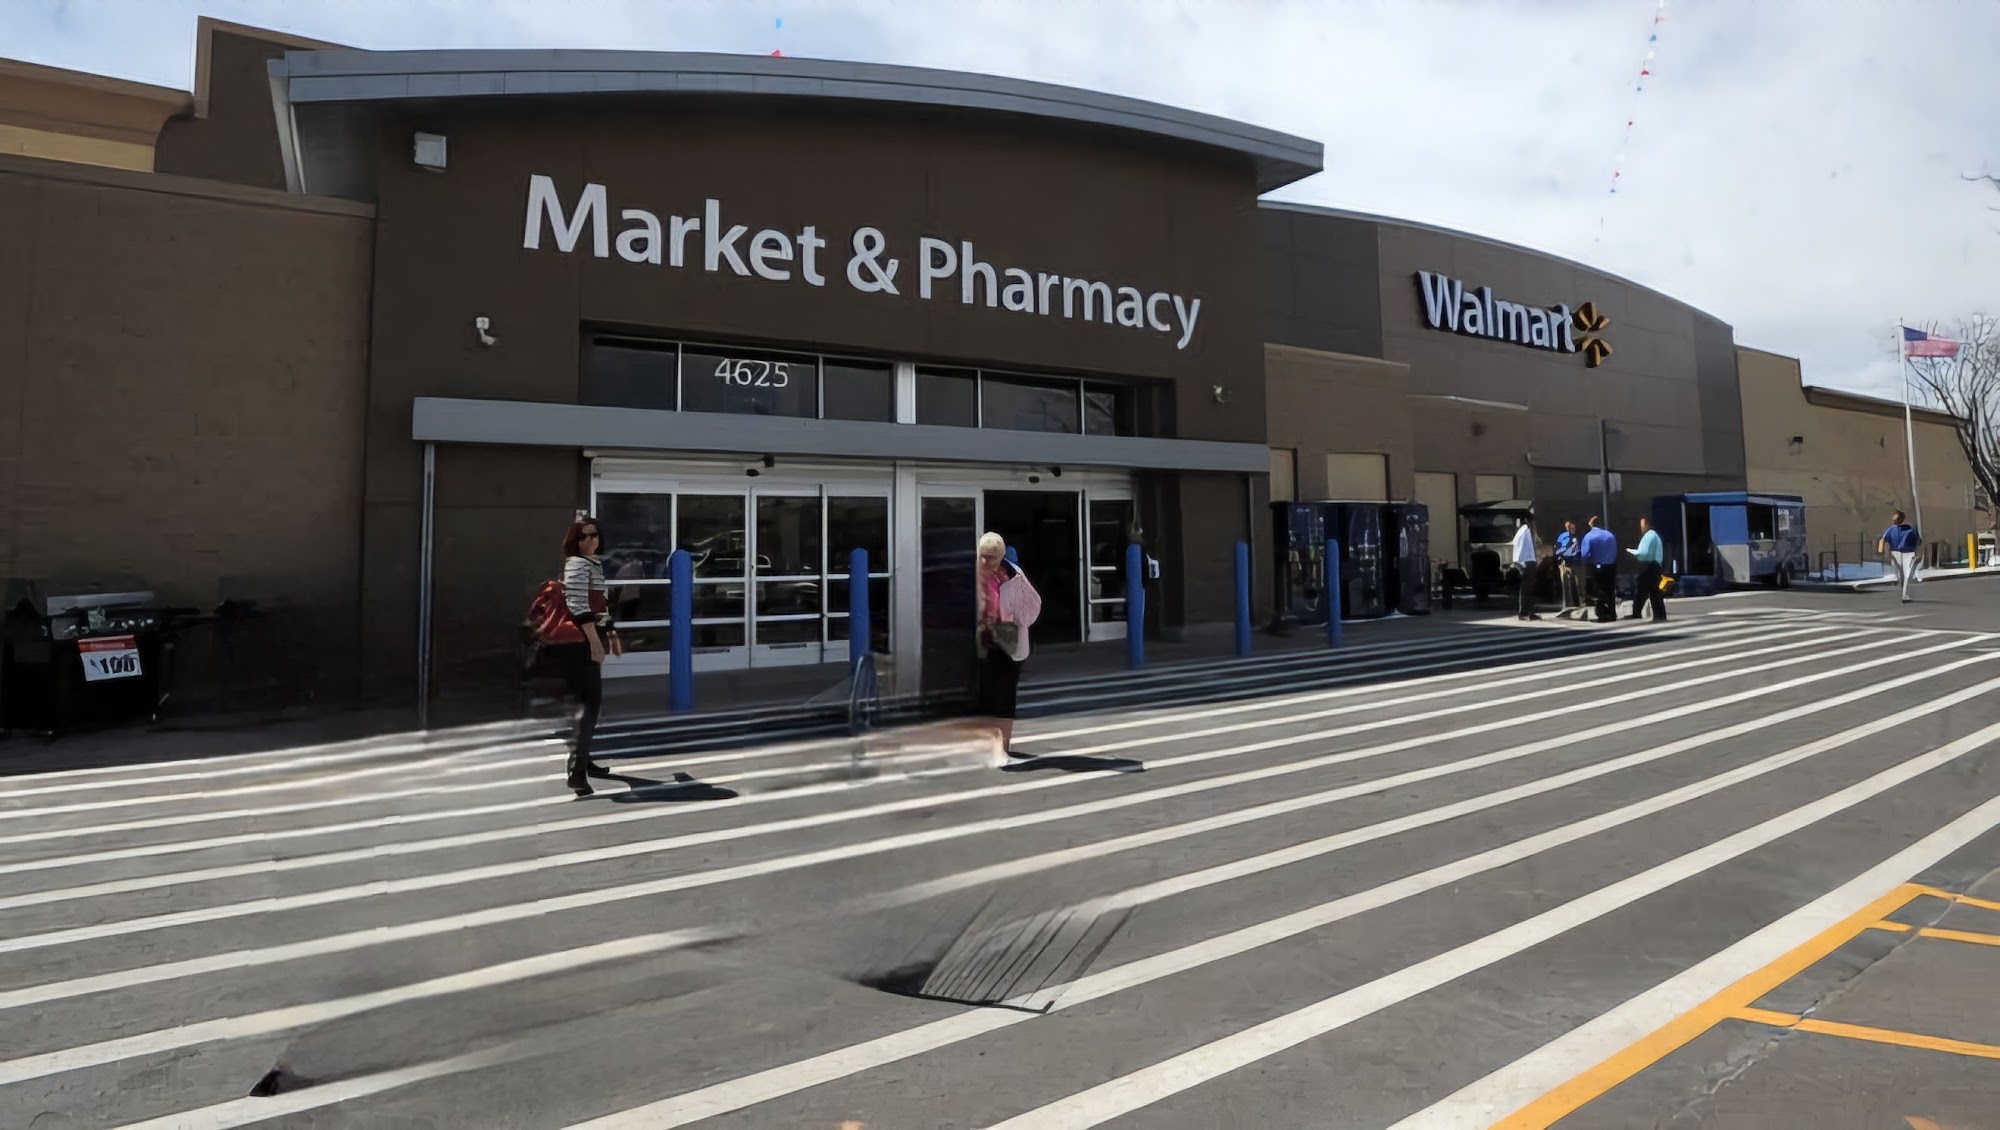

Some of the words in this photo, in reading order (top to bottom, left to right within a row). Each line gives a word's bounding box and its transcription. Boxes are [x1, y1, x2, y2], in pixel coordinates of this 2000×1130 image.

[524, 174, 826, 287] Market
[847, 226, 900, 296] &
[919, 236, 1201, 350] Pharmacy
[1416, 270, 1576, 354] Walmart
[714, 358, 789, 388] 4625
